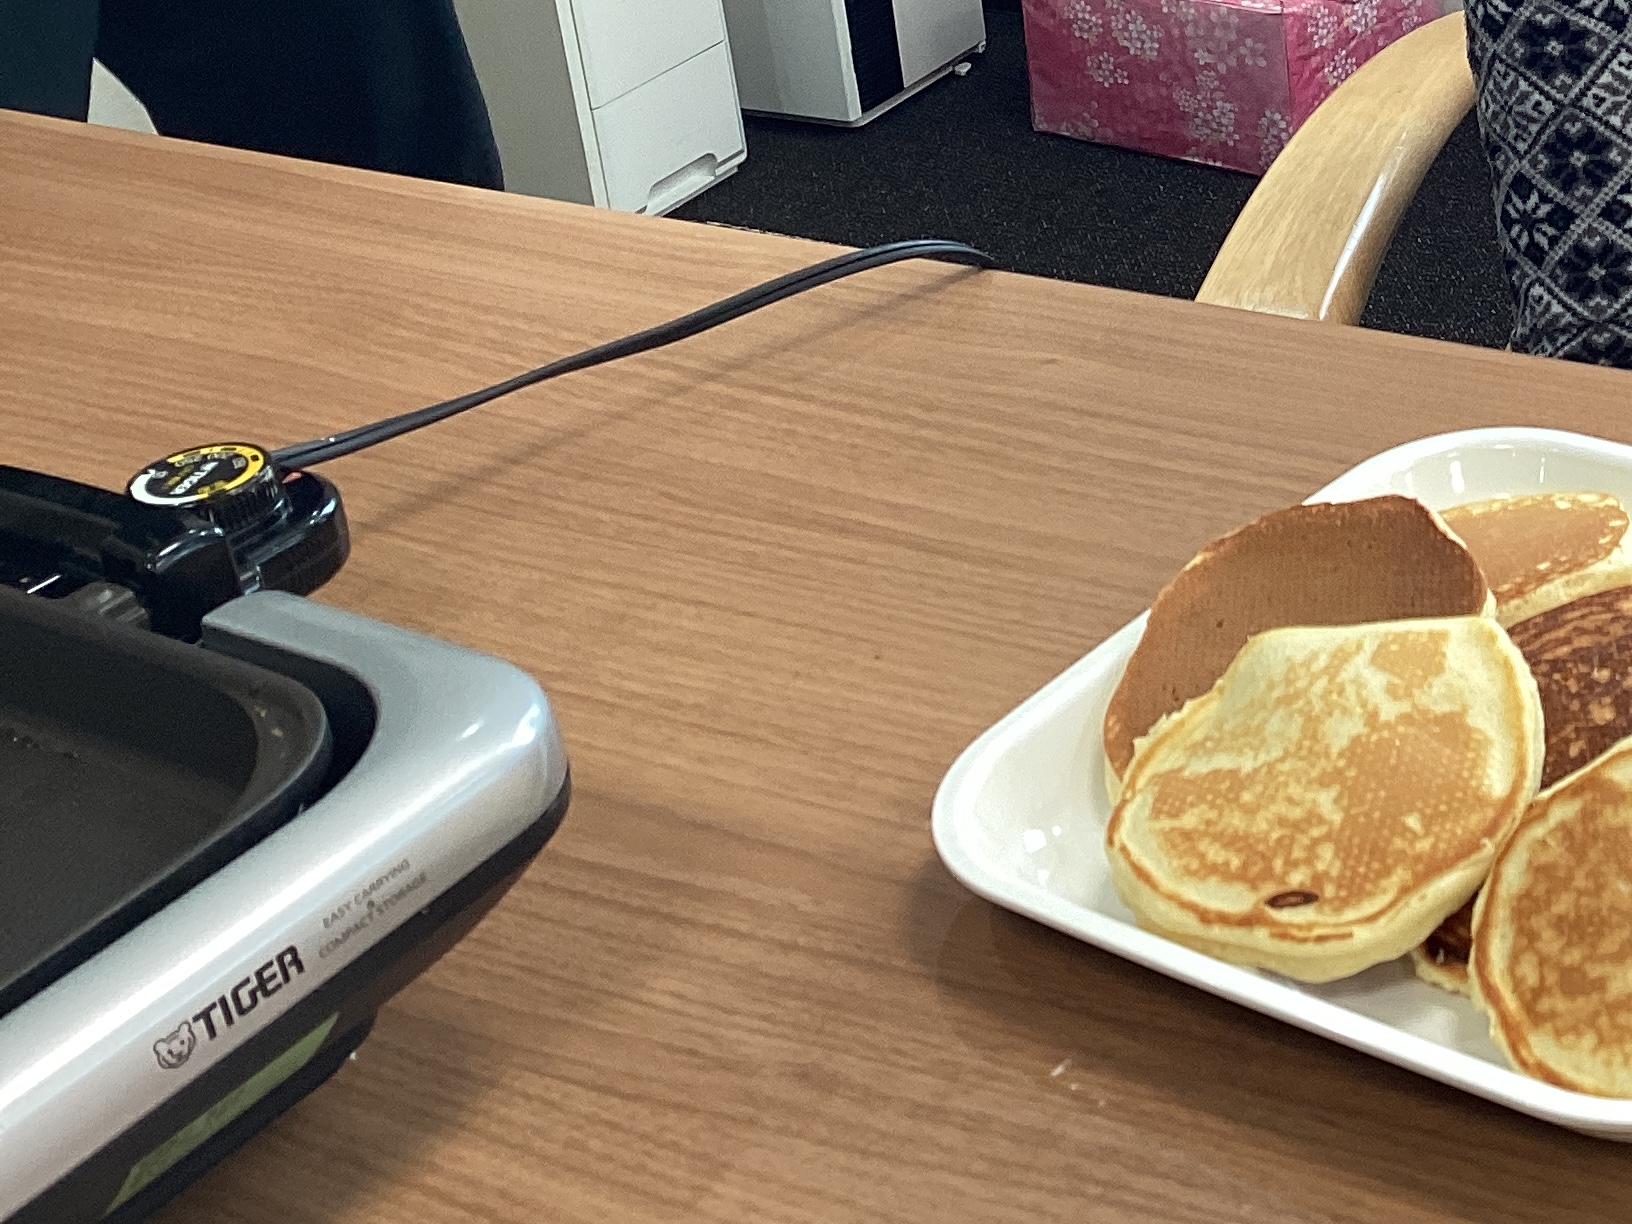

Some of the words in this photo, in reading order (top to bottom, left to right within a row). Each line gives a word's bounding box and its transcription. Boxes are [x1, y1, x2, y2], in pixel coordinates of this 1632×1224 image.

[318, 910, 374, 959] COMPACT
[376, 872, 427, 915] STORAGE
[322, 900, 352, 929] EASY
[354, 859, 410, 906] CARRYING
[192, 945, 305, 1041] TIGER
